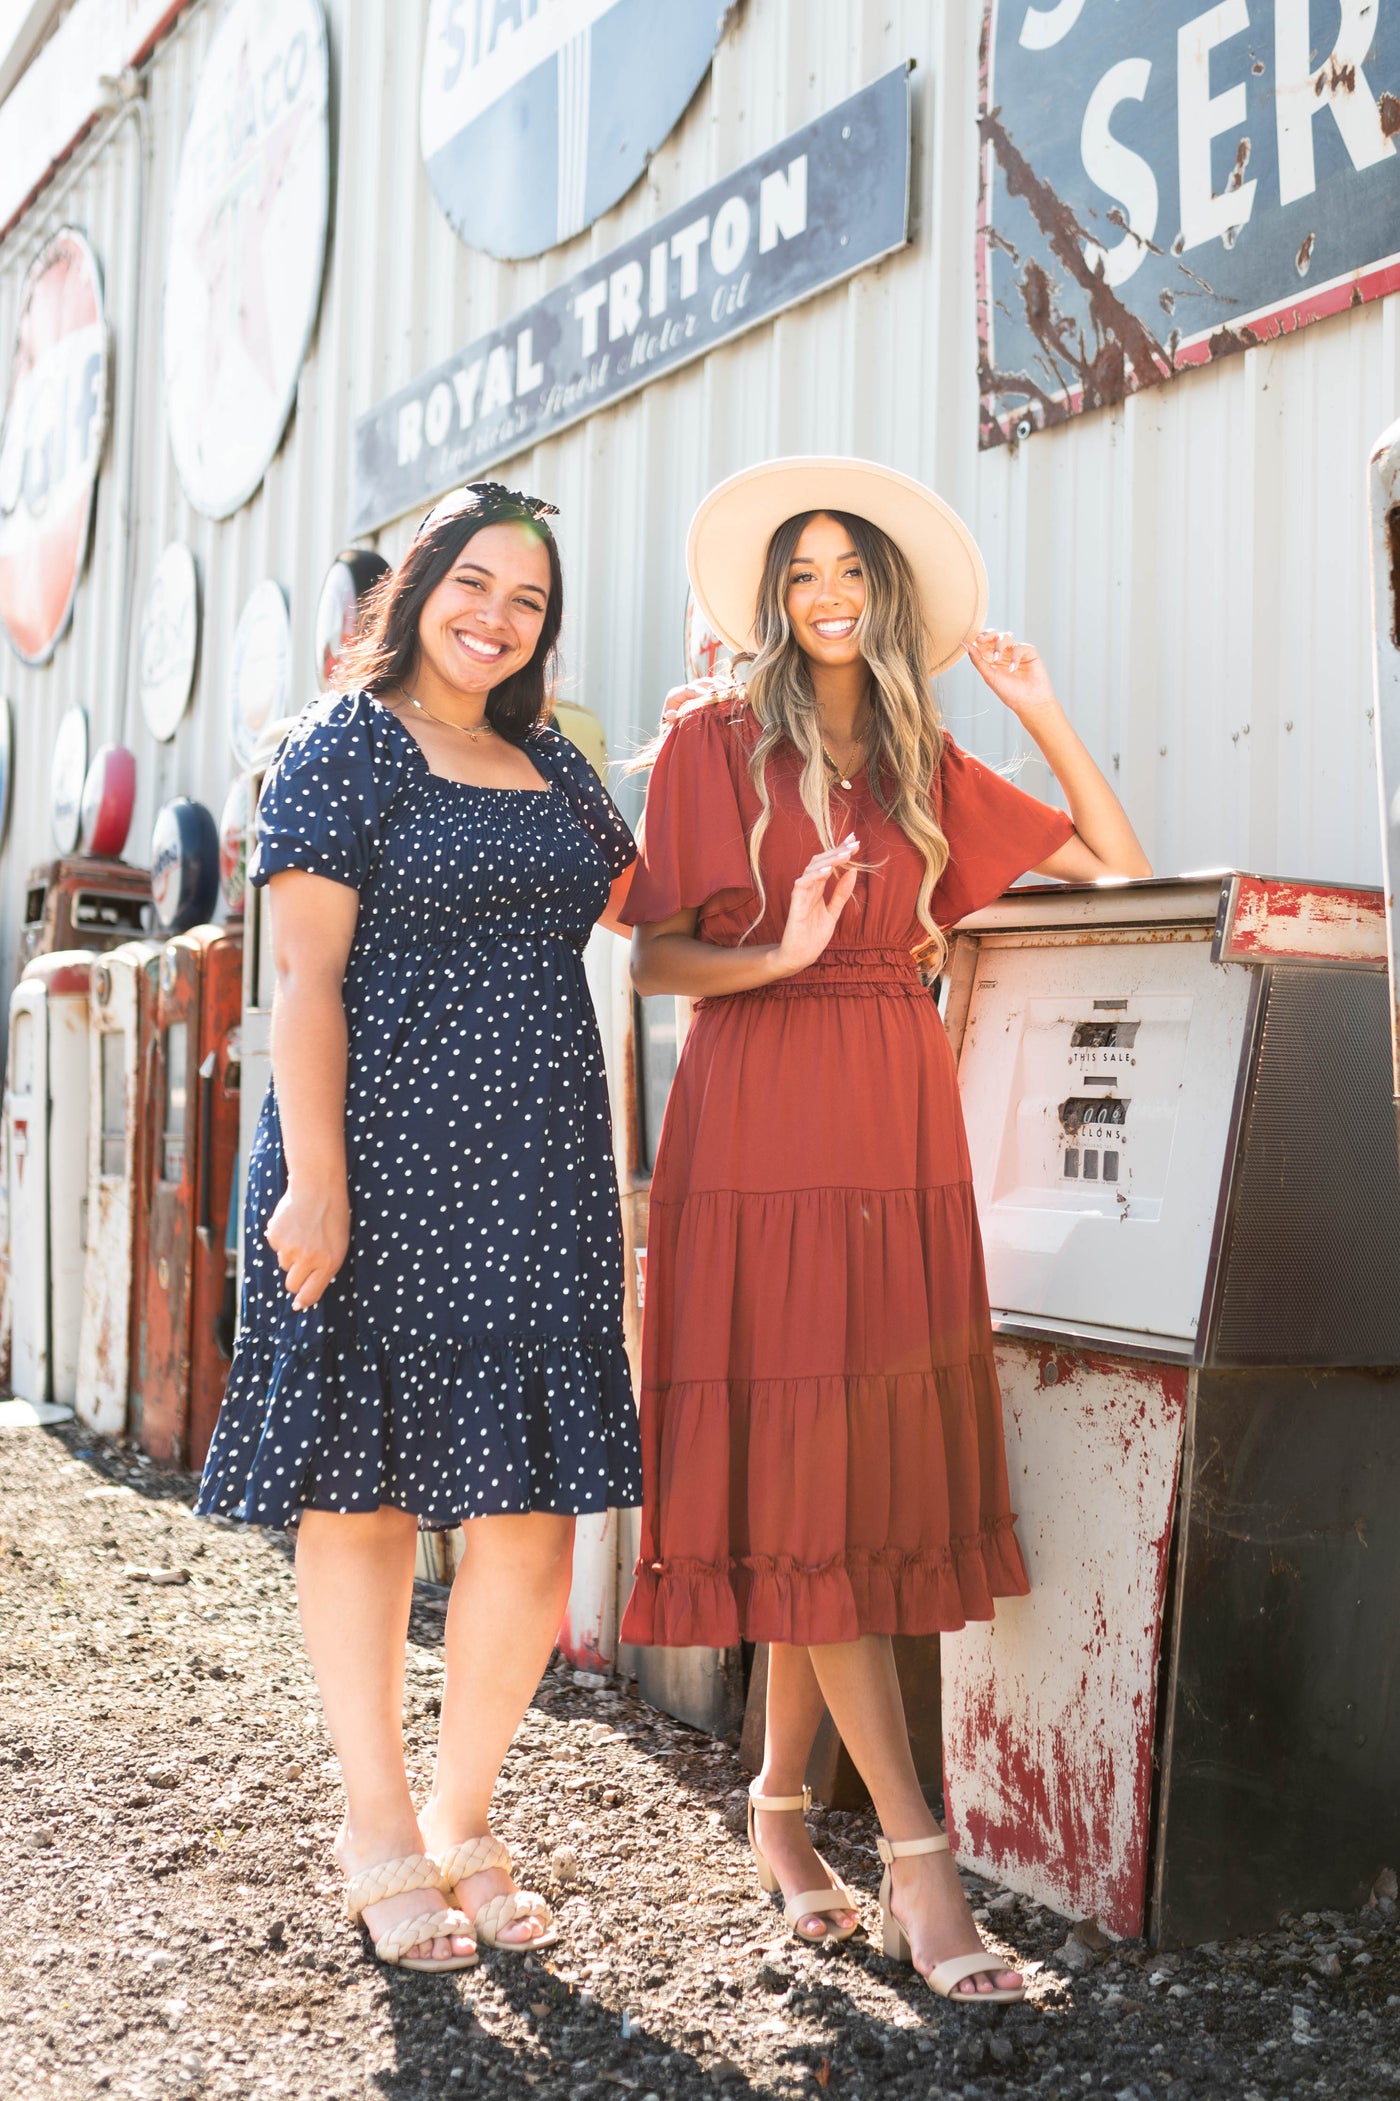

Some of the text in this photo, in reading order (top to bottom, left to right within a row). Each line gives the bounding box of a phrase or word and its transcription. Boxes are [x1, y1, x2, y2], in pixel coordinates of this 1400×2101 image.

[438, 0, 557, 91] STA
[1081, 0, 1397, 287] SER
[397, 154, 809, 466] ROYAL TRITON
[617, 313, 698, 376] Motor
[710, 271, 753, 323] Oil
[1074, 1053, 1130, 1062] THIS SALE
[1081, 1127, 1121, 1139] LLONS
